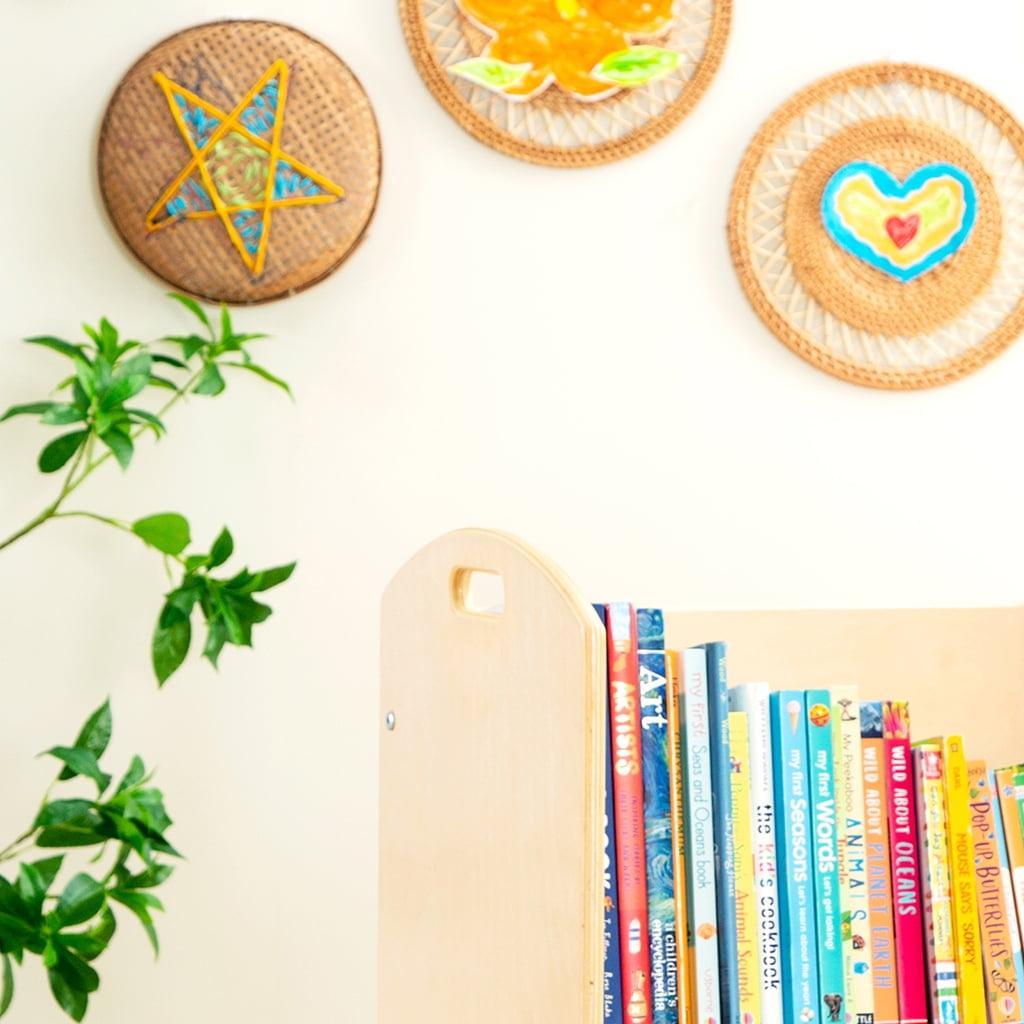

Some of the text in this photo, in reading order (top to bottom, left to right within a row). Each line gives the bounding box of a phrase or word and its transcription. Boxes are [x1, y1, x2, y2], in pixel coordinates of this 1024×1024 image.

[639, 665, 668, 730] Art
[611, 681, 640, 777] ARTISTS
[691, 744, 708, 776] Seas
[788, 748, 802, 770] my
[791, 771, 804, 796] first
[813, 749, 828, 771] my
[843, 755, 855, 812] Peekaboo
[693, 780, 709, 802] and
[817, 772, 831, 797] first
[694, 807, 711, 856] Oceans
[757, 805, 774, 834] the
[789, 798, 808, 883] Seasons
[816, 799, 838, 874] Words
[891, 745, 918, 916] WILD ABOUT OCEANS
[697, 860, 712, 888] book
[863, 746, 893, 988] WILD ABOUT PLANET EARTH
[956, 832, 970, 878] MOUSE
[960, 881, 973, 914] SAYS
[650, 918, 669, 1012] encyclopedia
[761, 896, 780, 990] cookbook
[963, 922, 976, 965] SORRY
[664, 934, 679, 1008] children's
[738, 949, 754, 1003] Sounds
